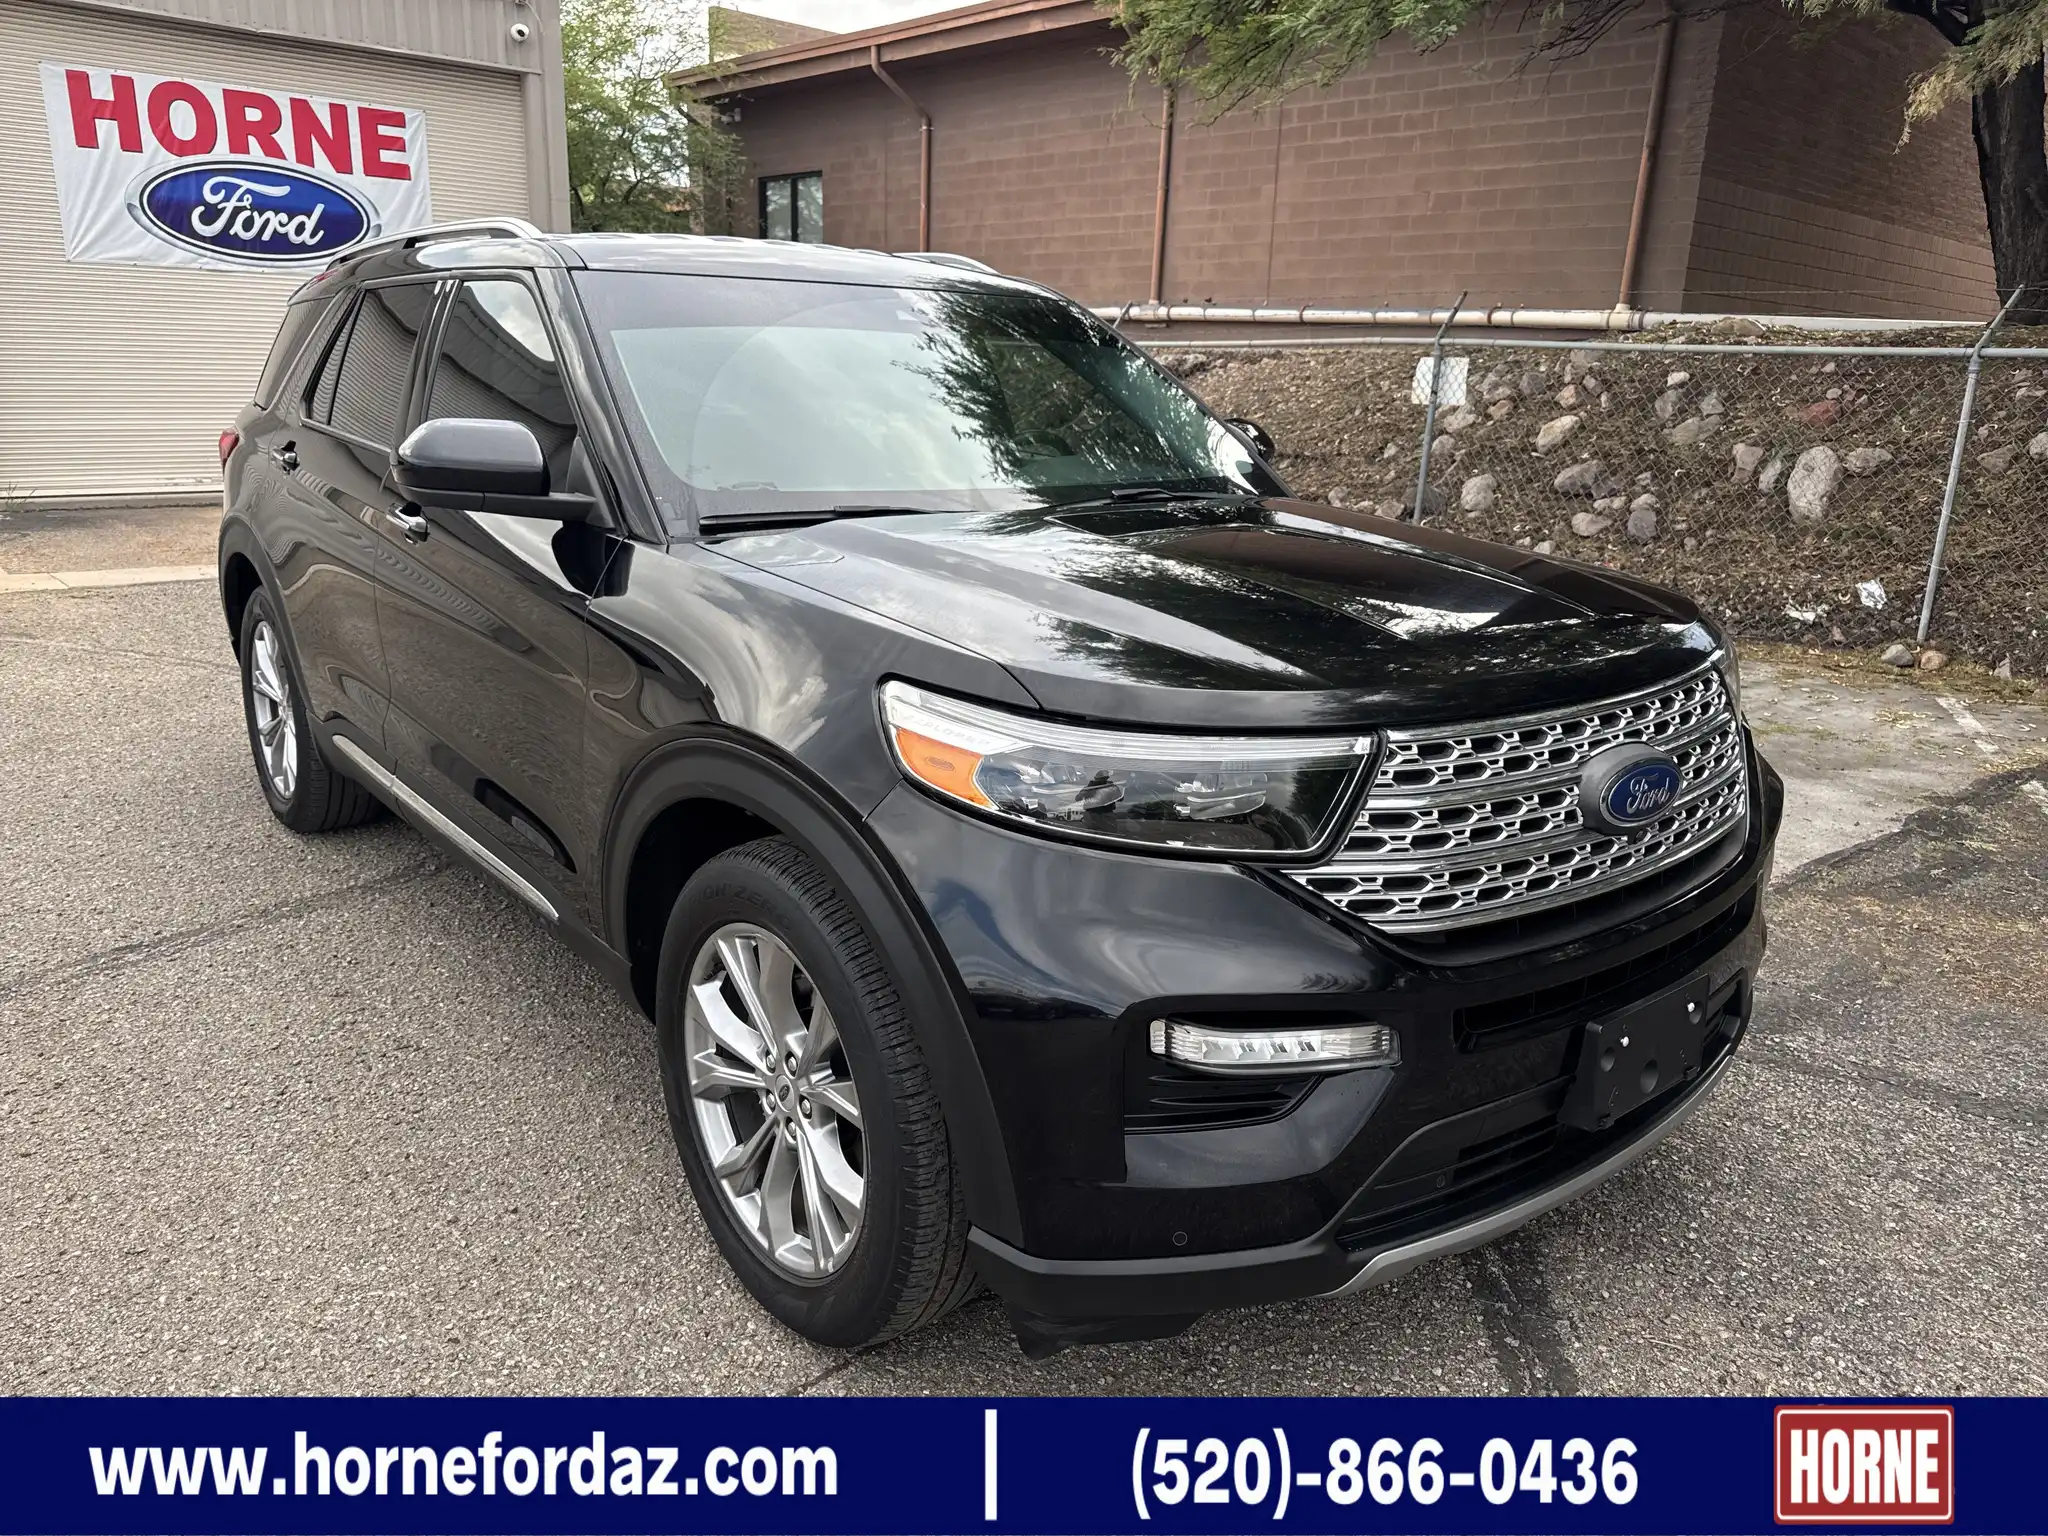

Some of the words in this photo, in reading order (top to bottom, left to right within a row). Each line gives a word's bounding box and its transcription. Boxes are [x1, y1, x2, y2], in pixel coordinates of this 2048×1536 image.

[65, 69, 411, 180] HORNE
[191, 176, 325, 246] Ford
[1626, 772, 1671, 814] Ford
